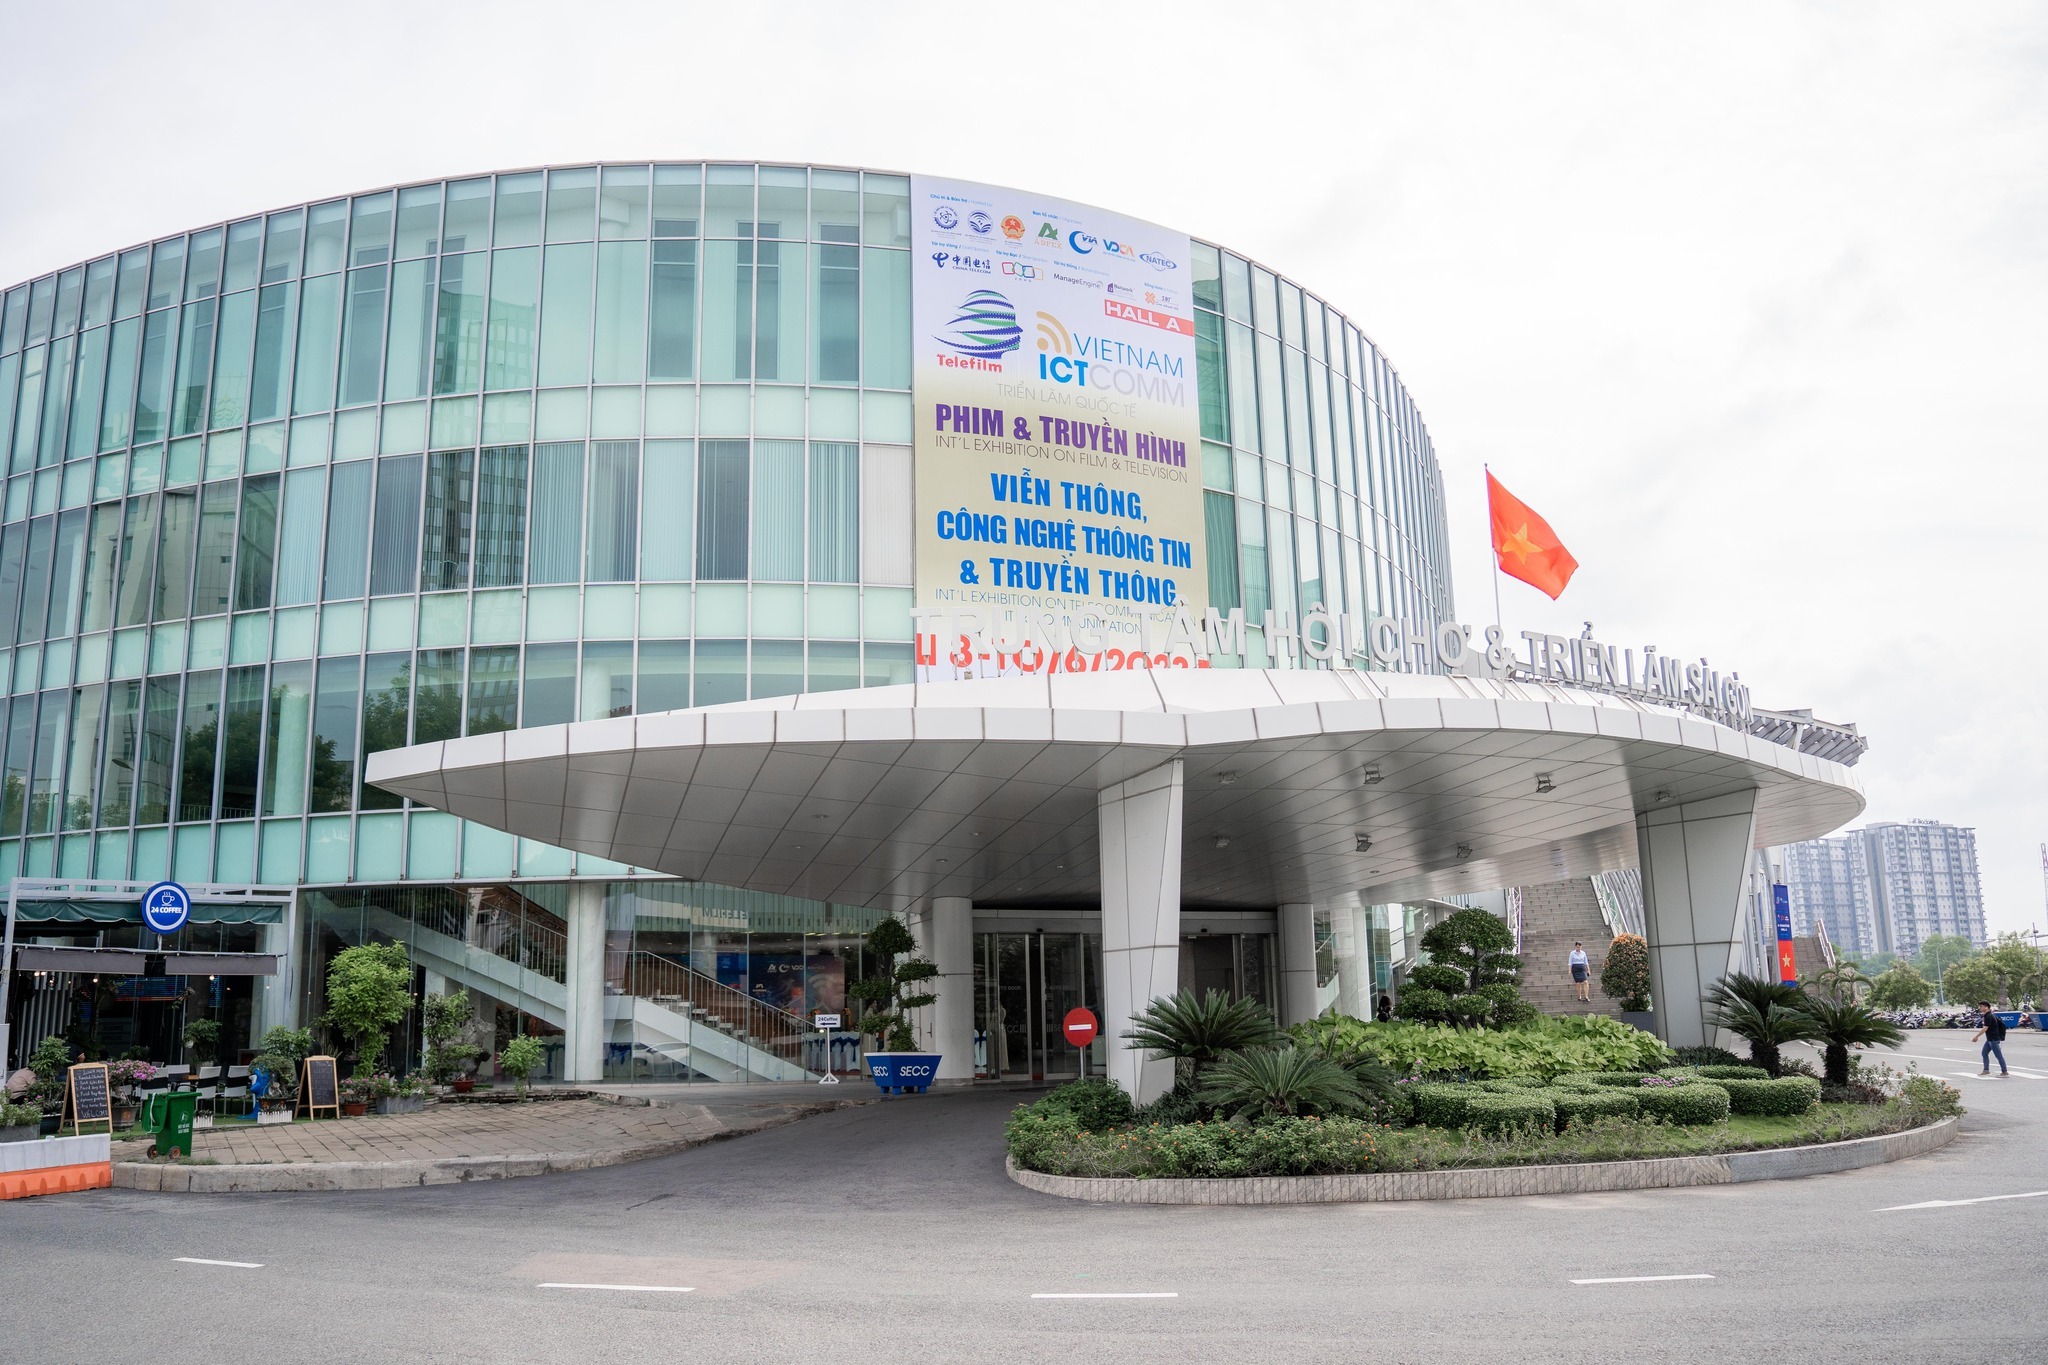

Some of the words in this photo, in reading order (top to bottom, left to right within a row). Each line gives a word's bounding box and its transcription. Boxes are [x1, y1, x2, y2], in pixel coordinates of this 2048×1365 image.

[1034, 240, 1062, 249] ADPEX
[952, 254, 990, 270] 中国电信
[1146, 255, 1171, 268] NATEC
[1054, 273, 1101, 288] ManageEngine
[1106, 301, 1160, 326] HALL
[1166, 317, 1180, 332] A
[936, 353, 1002, 373] Telefilm
[1074, 333, 1184, 378] VIETNAM
[997, 380, 1036, 400] TRIỂN
[1040, 387, 1072, 406] LÃM
[1075, 391, 1120, 414] QUỐC
[1123, 402, 1136, 418] TẾ
[936, 403, 1004, 438] PHIM
[1014, 416, 1032, 442] &
[1039, 416, 1128, 456] TRUYỀN
[1136, 431, 1186, 468] HÌNH
[975, 438, 1050, 460] EXHIBITION
[1054, 448, 1076, 464] ON
[1080, 454, 1108, 470] FILM
[1112, 458, 1122, 471] &
[1124, 460, 1188, 484] TELEVISION
[990, 467, 1050, 506] VIỄN
[1060, 482, 1148, 524] THÔNG,
[937, 507, 1007, 544] CÔNG
[1014, 518, 1077, 556] NGHỆ
[1082, 526, 1154, 562] THÔNG
[1159, 538, 1192, 569] TIN
[960, 560, 980, 584] &
[989, 554, 1090, 595] TRUYỀN
[1099, 570, 1177, 607] THÔNG
[971, 590, 1042, 608] EXHIBITION
[1045, 597, 1066, 610] ON
[910, 606, 1109, 656] TRUNG
[1130, 594, 1246, 656] TÂM
[1485, 625, 1516, 670] &
[1521, 621, 1620, 687] TRIỂN
[1624, 645, 1685, 698] LÃM
[1686, 657, 1722, 710] SÀI
[151, 906, 159, 914] 24
[160, 906, 182, 914] COFFEE
[872, 1066, 889, 1077] SECC
[900, 1066, 930, 1076] SECC
